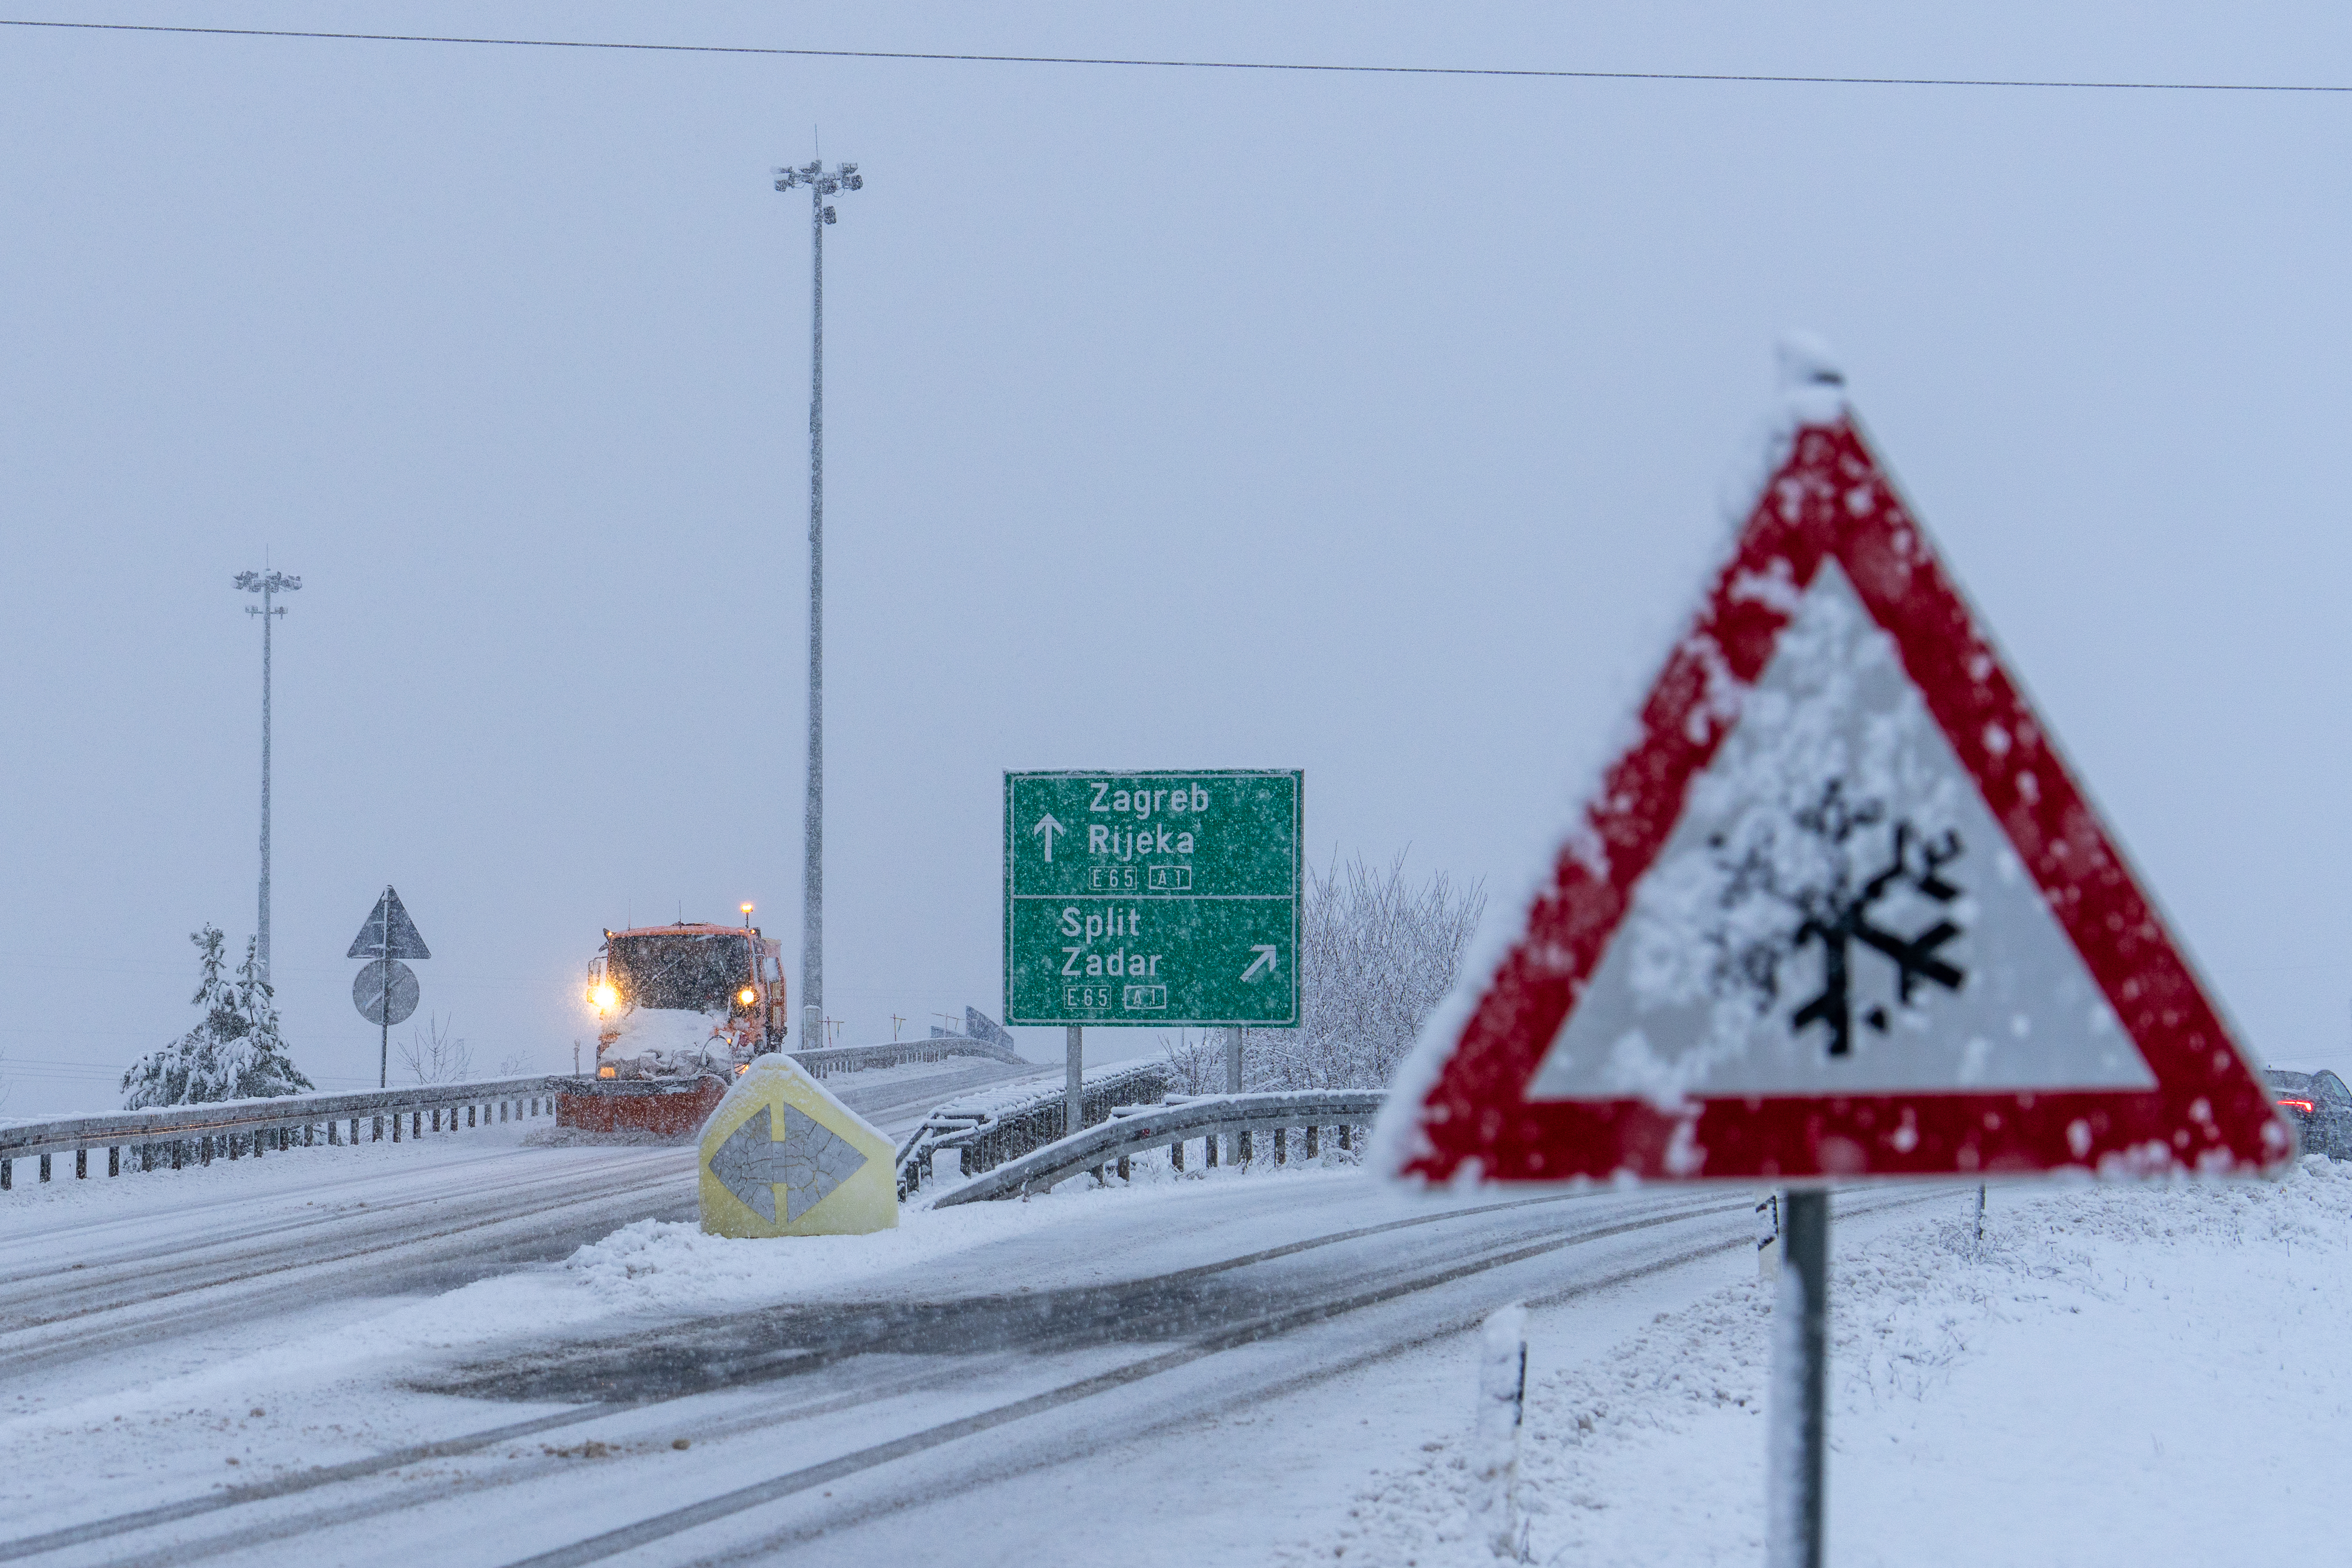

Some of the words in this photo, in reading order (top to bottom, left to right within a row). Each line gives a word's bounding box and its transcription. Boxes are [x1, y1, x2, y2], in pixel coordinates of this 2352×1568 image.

[1090, 782, 1208, 820] Zagreb
[1089, 824, 1194, 861] Rijeka
[1061, 907, 1140, 944] Split
[1061, 947, 1162, 976] Zadar
